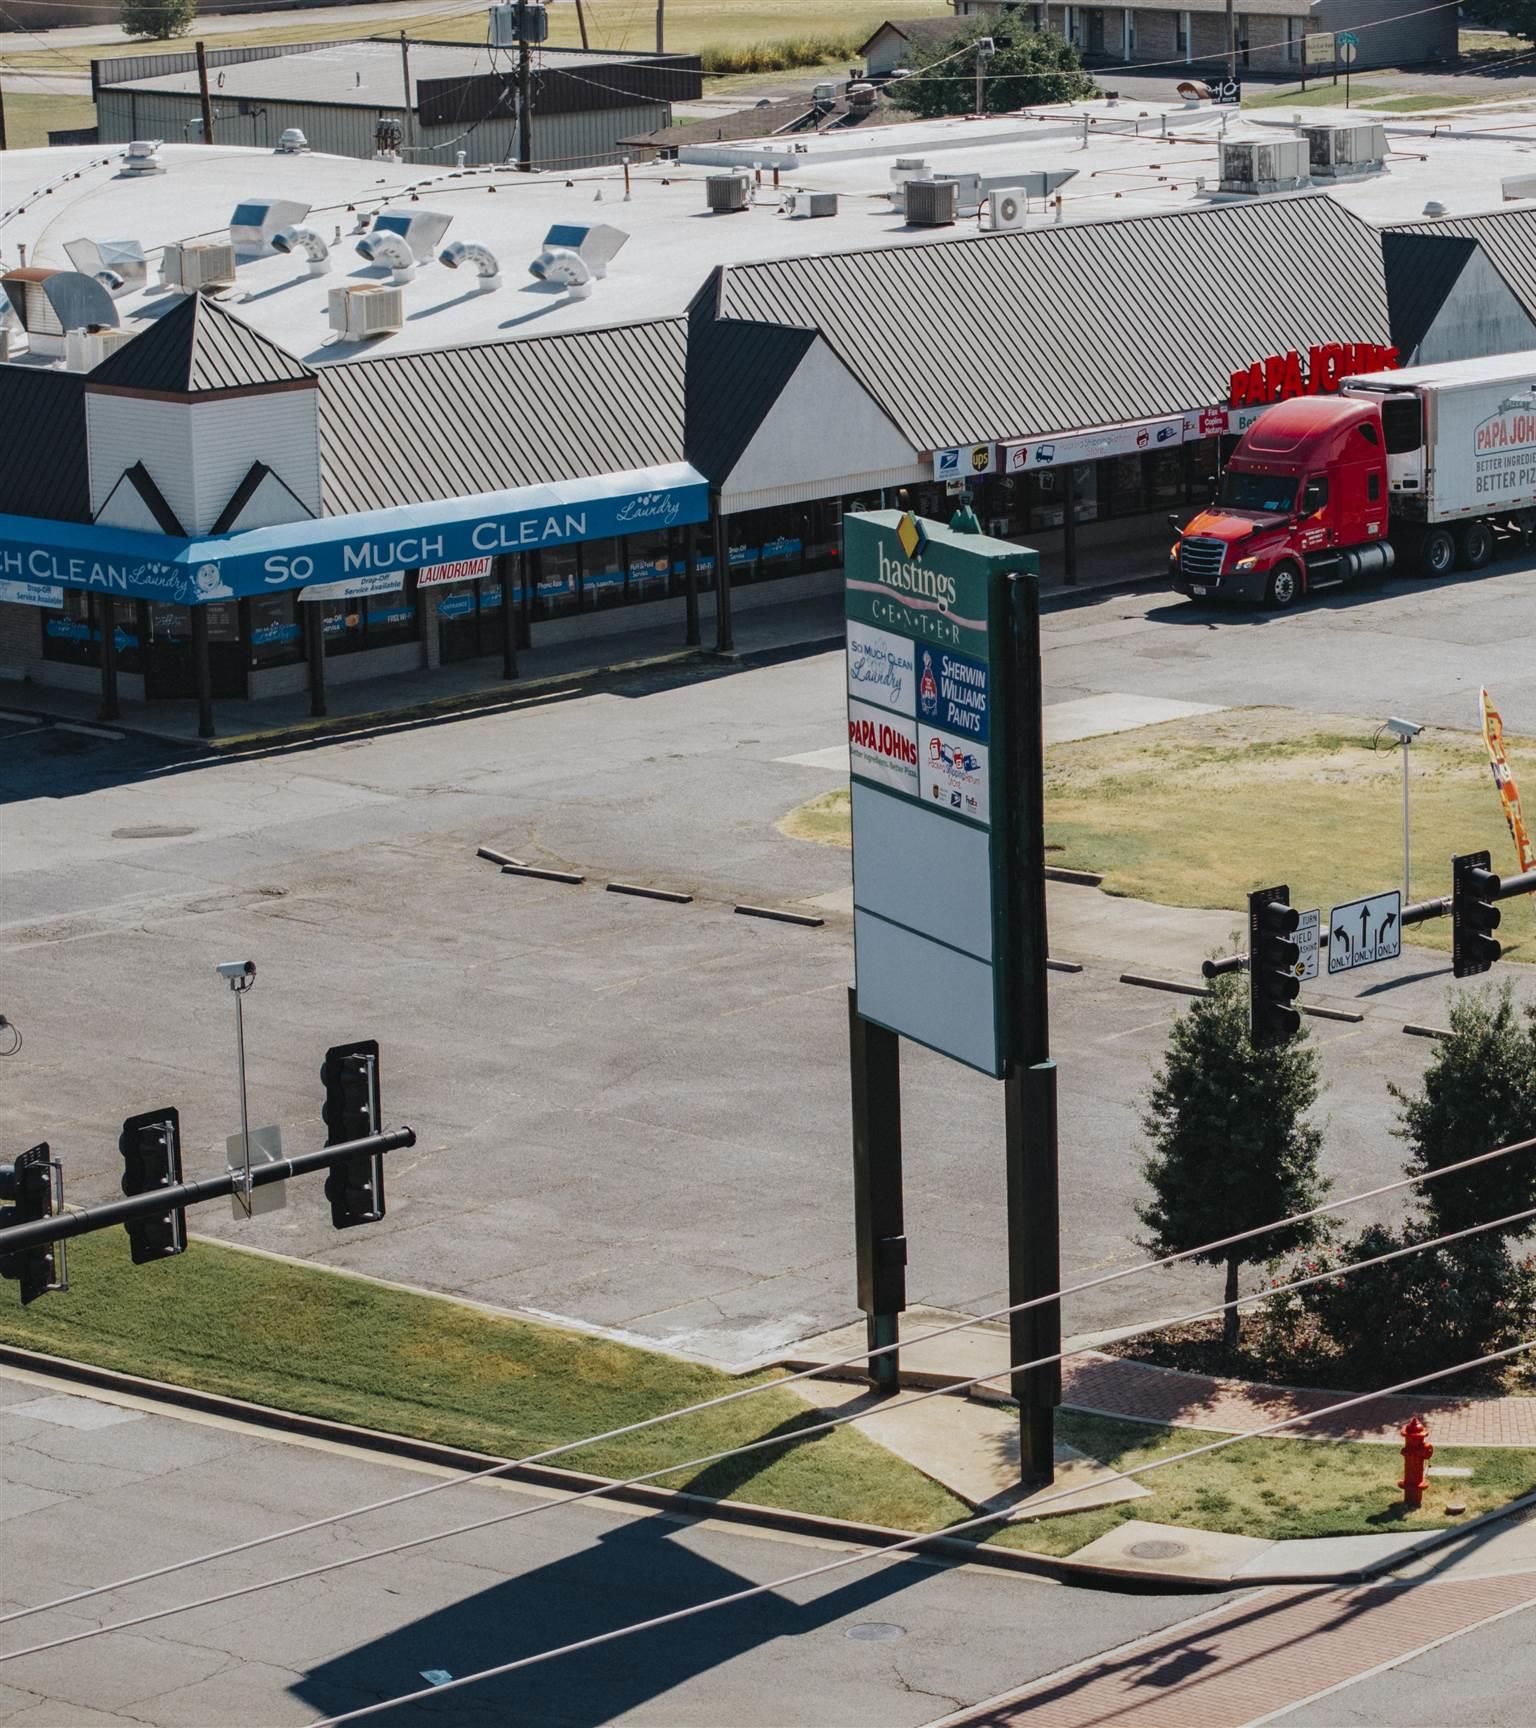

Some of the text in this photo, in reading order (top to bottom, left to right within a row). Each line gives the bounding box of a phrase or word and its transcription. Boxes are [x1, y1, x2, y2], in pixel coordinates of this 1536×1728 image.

[1229, 342, 1400, 408] PAPA JOHNS
[1477, 418, 1507, 450] PAPA
[1476, 458, 1502, 472] BETTER
[1476, 471, 1516, 493] BETTER
[616, 494, 680, 524] Laundry
[344, 535, 443, 573] MUCH
[472, 512, 586, 550] CLEAN
[28, 549, 128, 590] CLEAN
[128, 564, 188, 600] Laundry
[361, 574, 391, 585] Drop-Off
[419, 557, 490, 584] LAUNDROMAT
[878, 541, 956, 614] hastings
[344, 581, 402, 596] Service Available
[941, 655, 986, 688] SHERWIN
[940, 677, 986, 711] WILLIAMS
[947, 702, 980, 732] PAINTS
[848, 720, 917, 766] PAPA JOHNS
[1291, 931, 1312, 944] YIELD
[1331, 942, 1398, 969] ONLY ONLY ONLY
